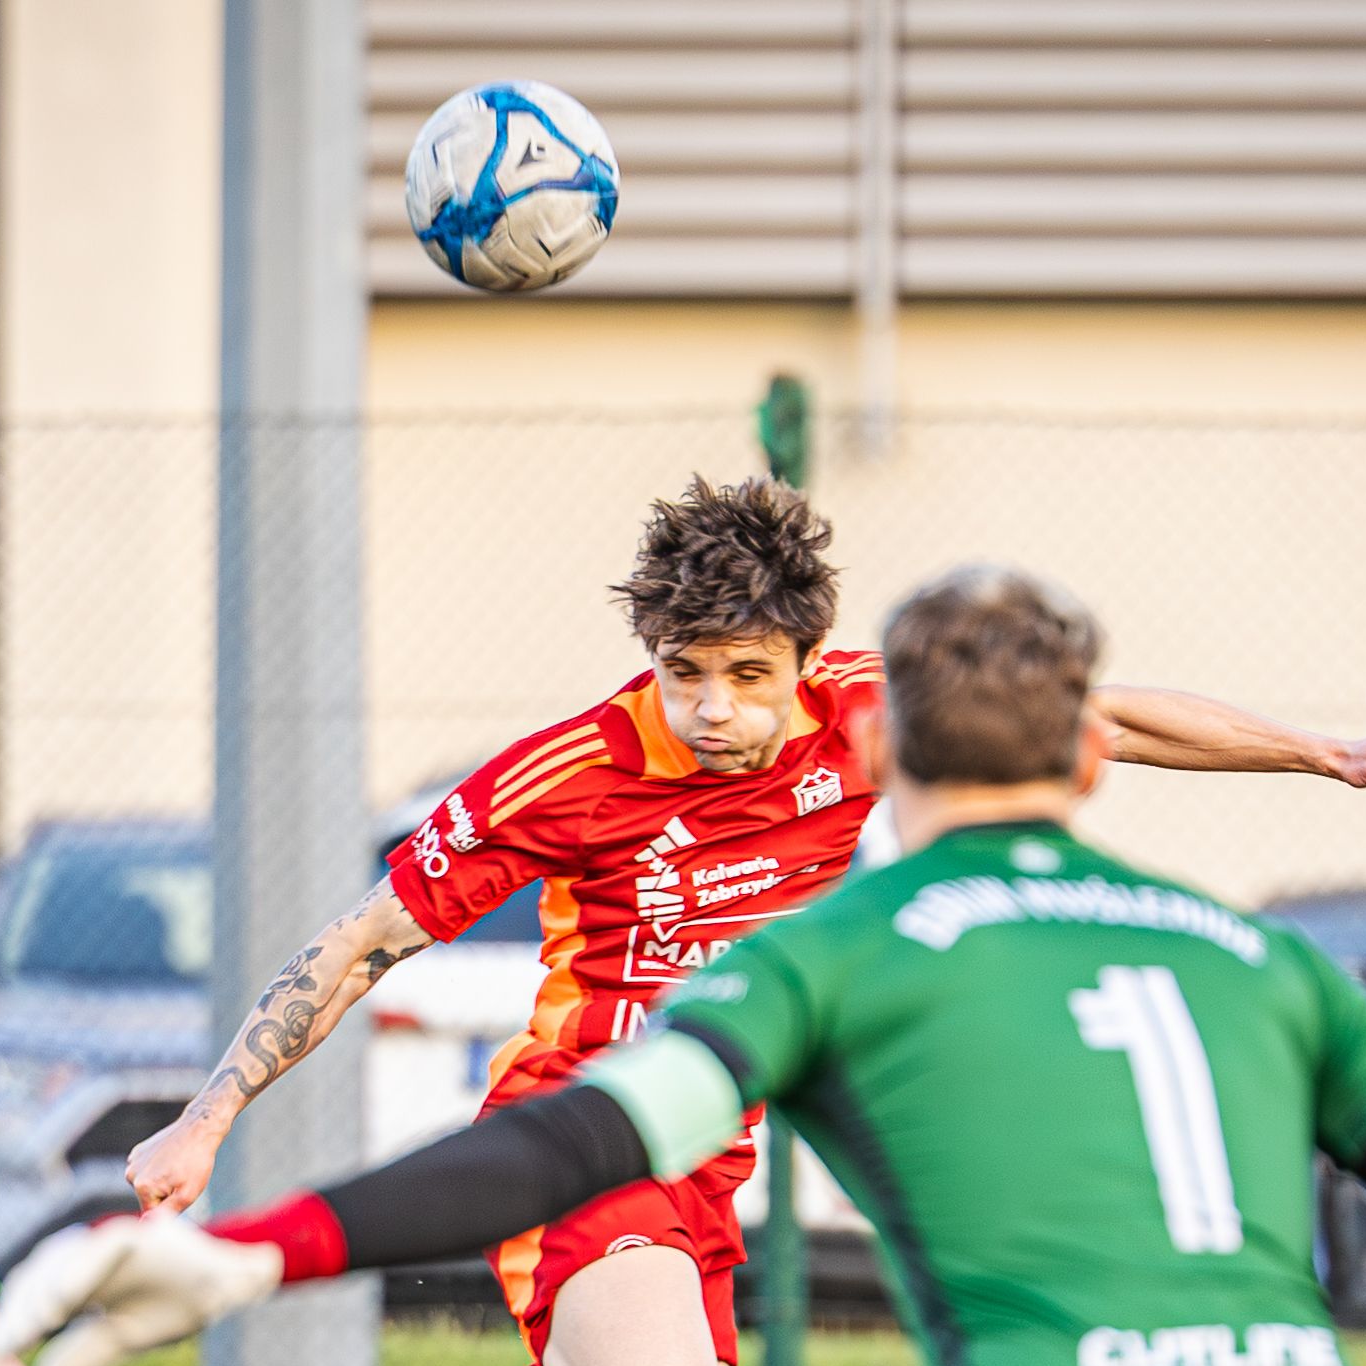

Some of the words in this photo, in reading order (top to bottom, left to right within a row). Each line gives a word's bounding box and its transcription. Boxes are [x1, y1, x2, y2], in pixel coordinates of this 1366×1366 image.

[692, 856, 780, 887] Kalwaria
[696, 864, 820, 908] Zebrzyd
[1067, 964, 1244, 1254] 1
